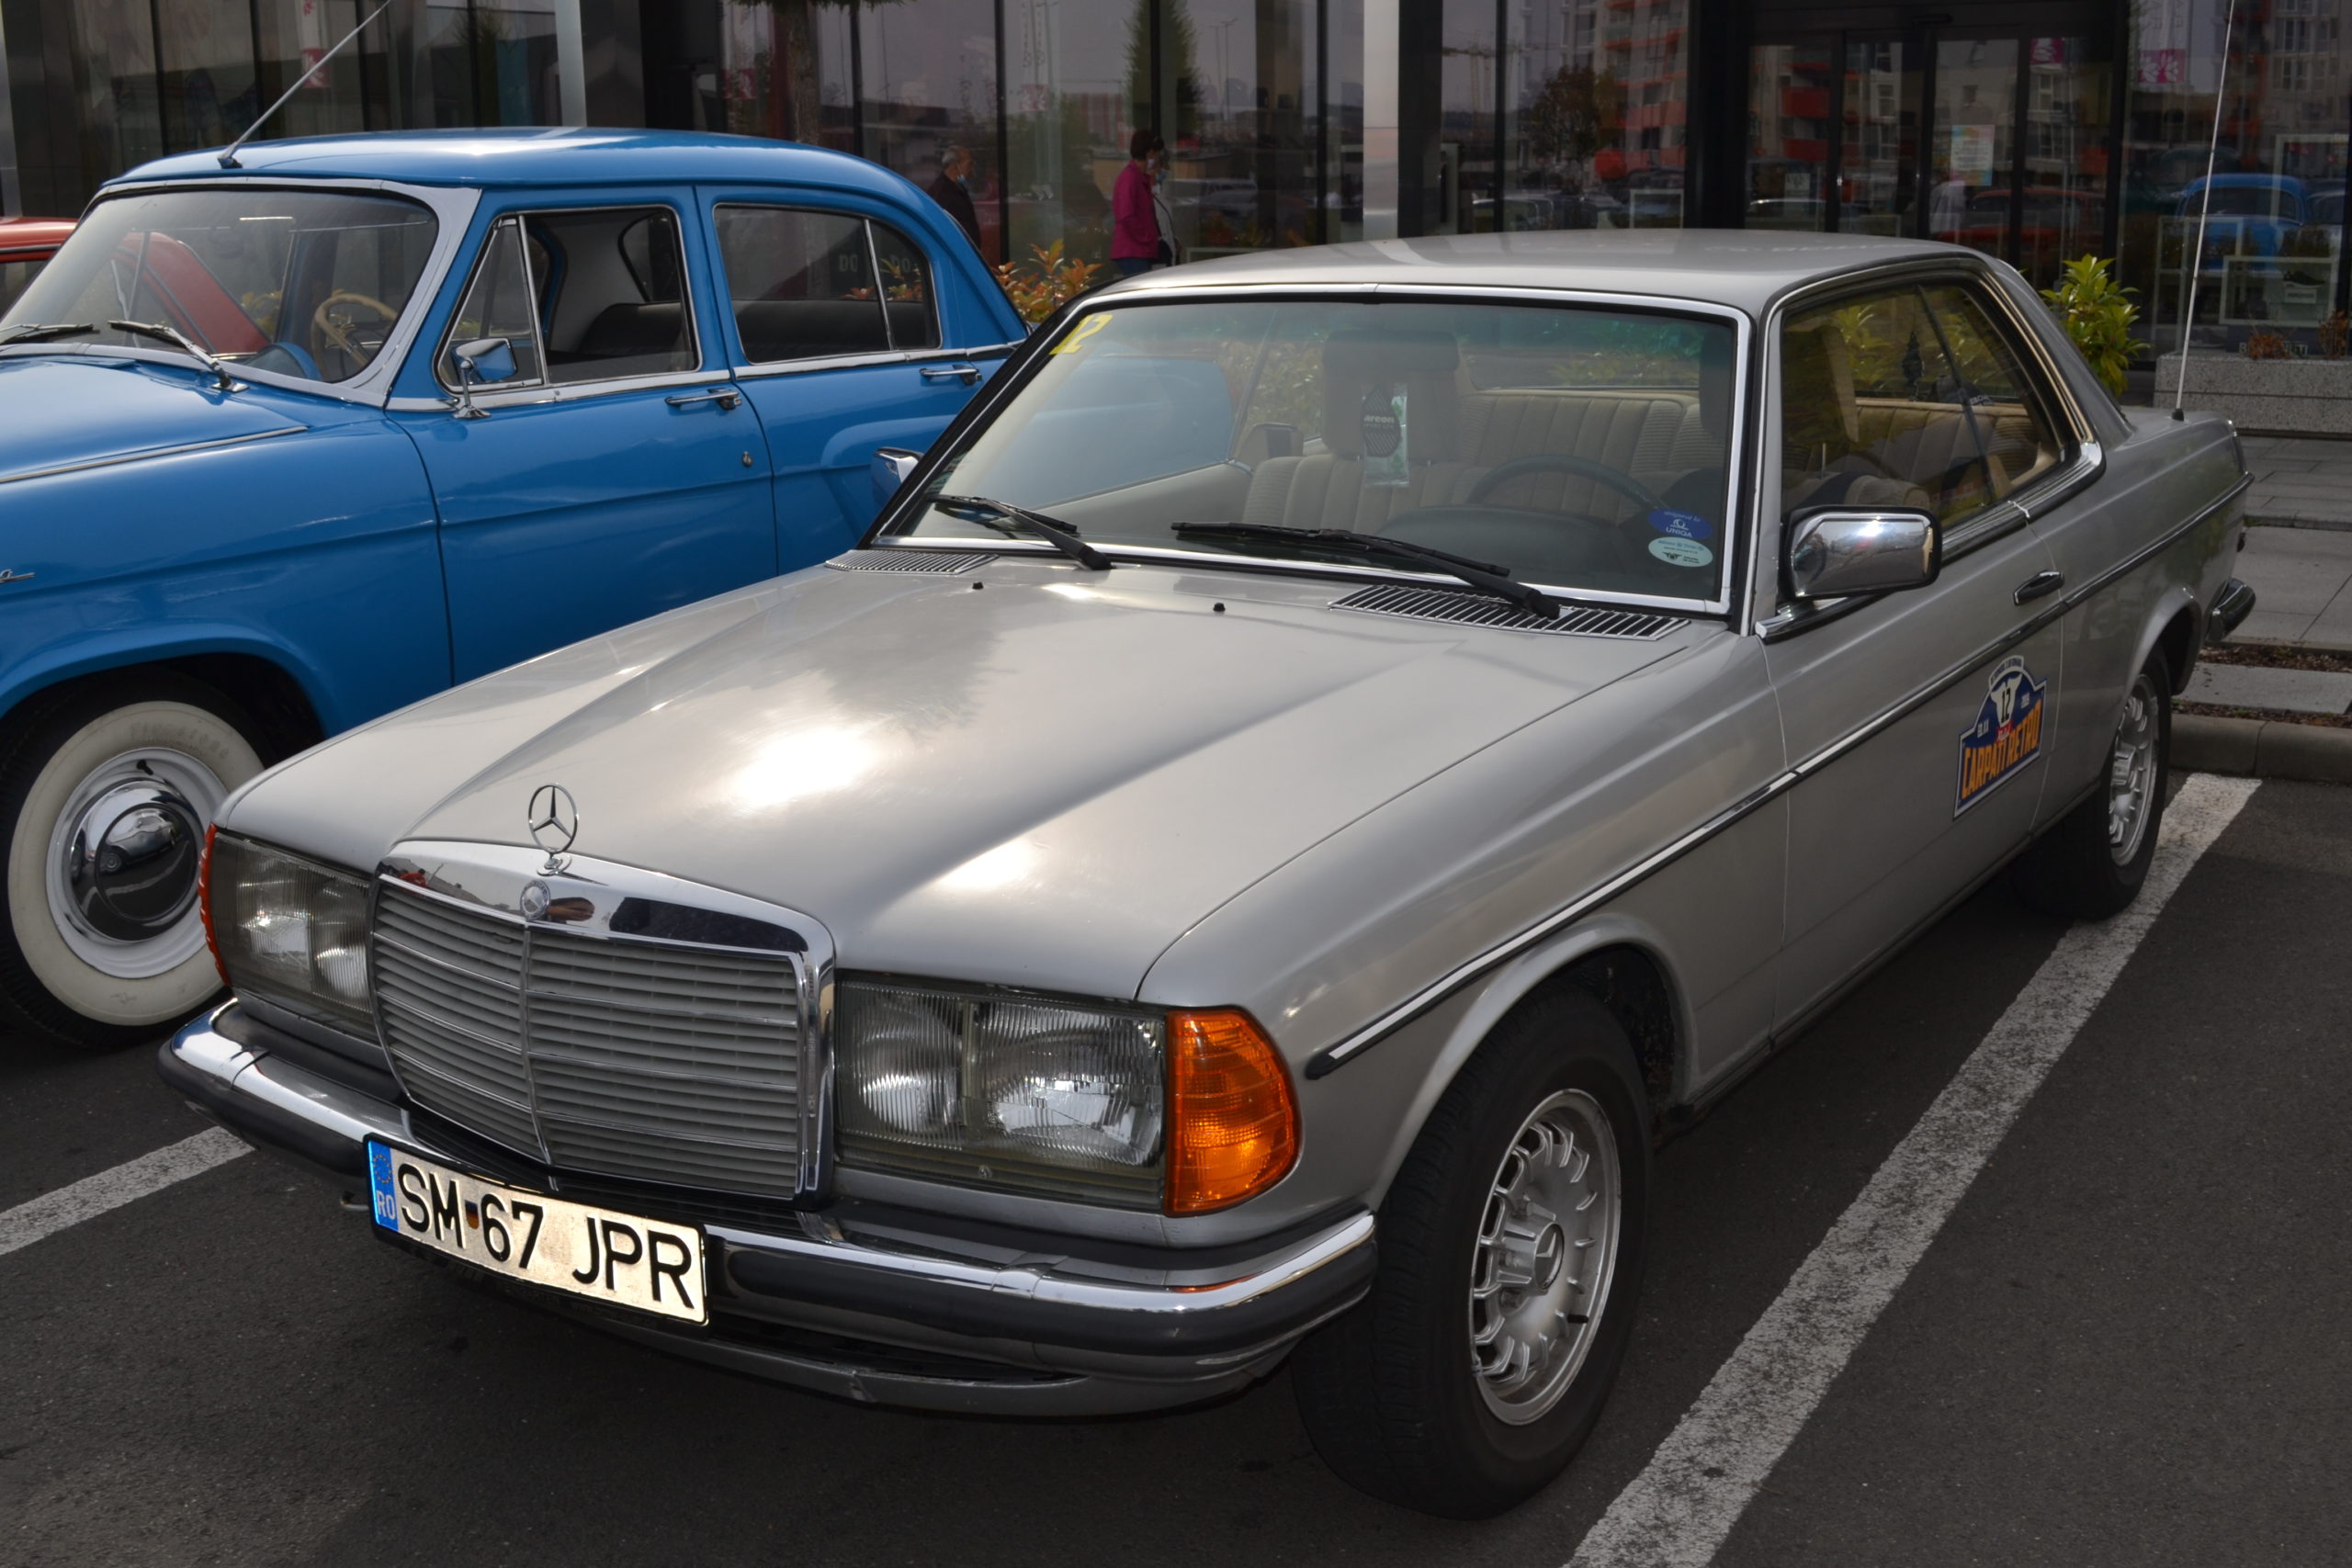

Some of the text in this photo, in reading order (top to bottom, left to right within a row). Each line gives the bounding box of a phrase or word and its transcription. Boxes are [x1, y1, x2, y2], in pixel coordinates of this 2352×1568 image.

[1048, 313, 1114, 355] 12
[1666, 527, 1692, 538] UNIQA
[2001, 687, 2011, 724] 12
[377, 1190, 396, 1220] RO
[397, 1163, 695, 1309] SM 67 JPR
